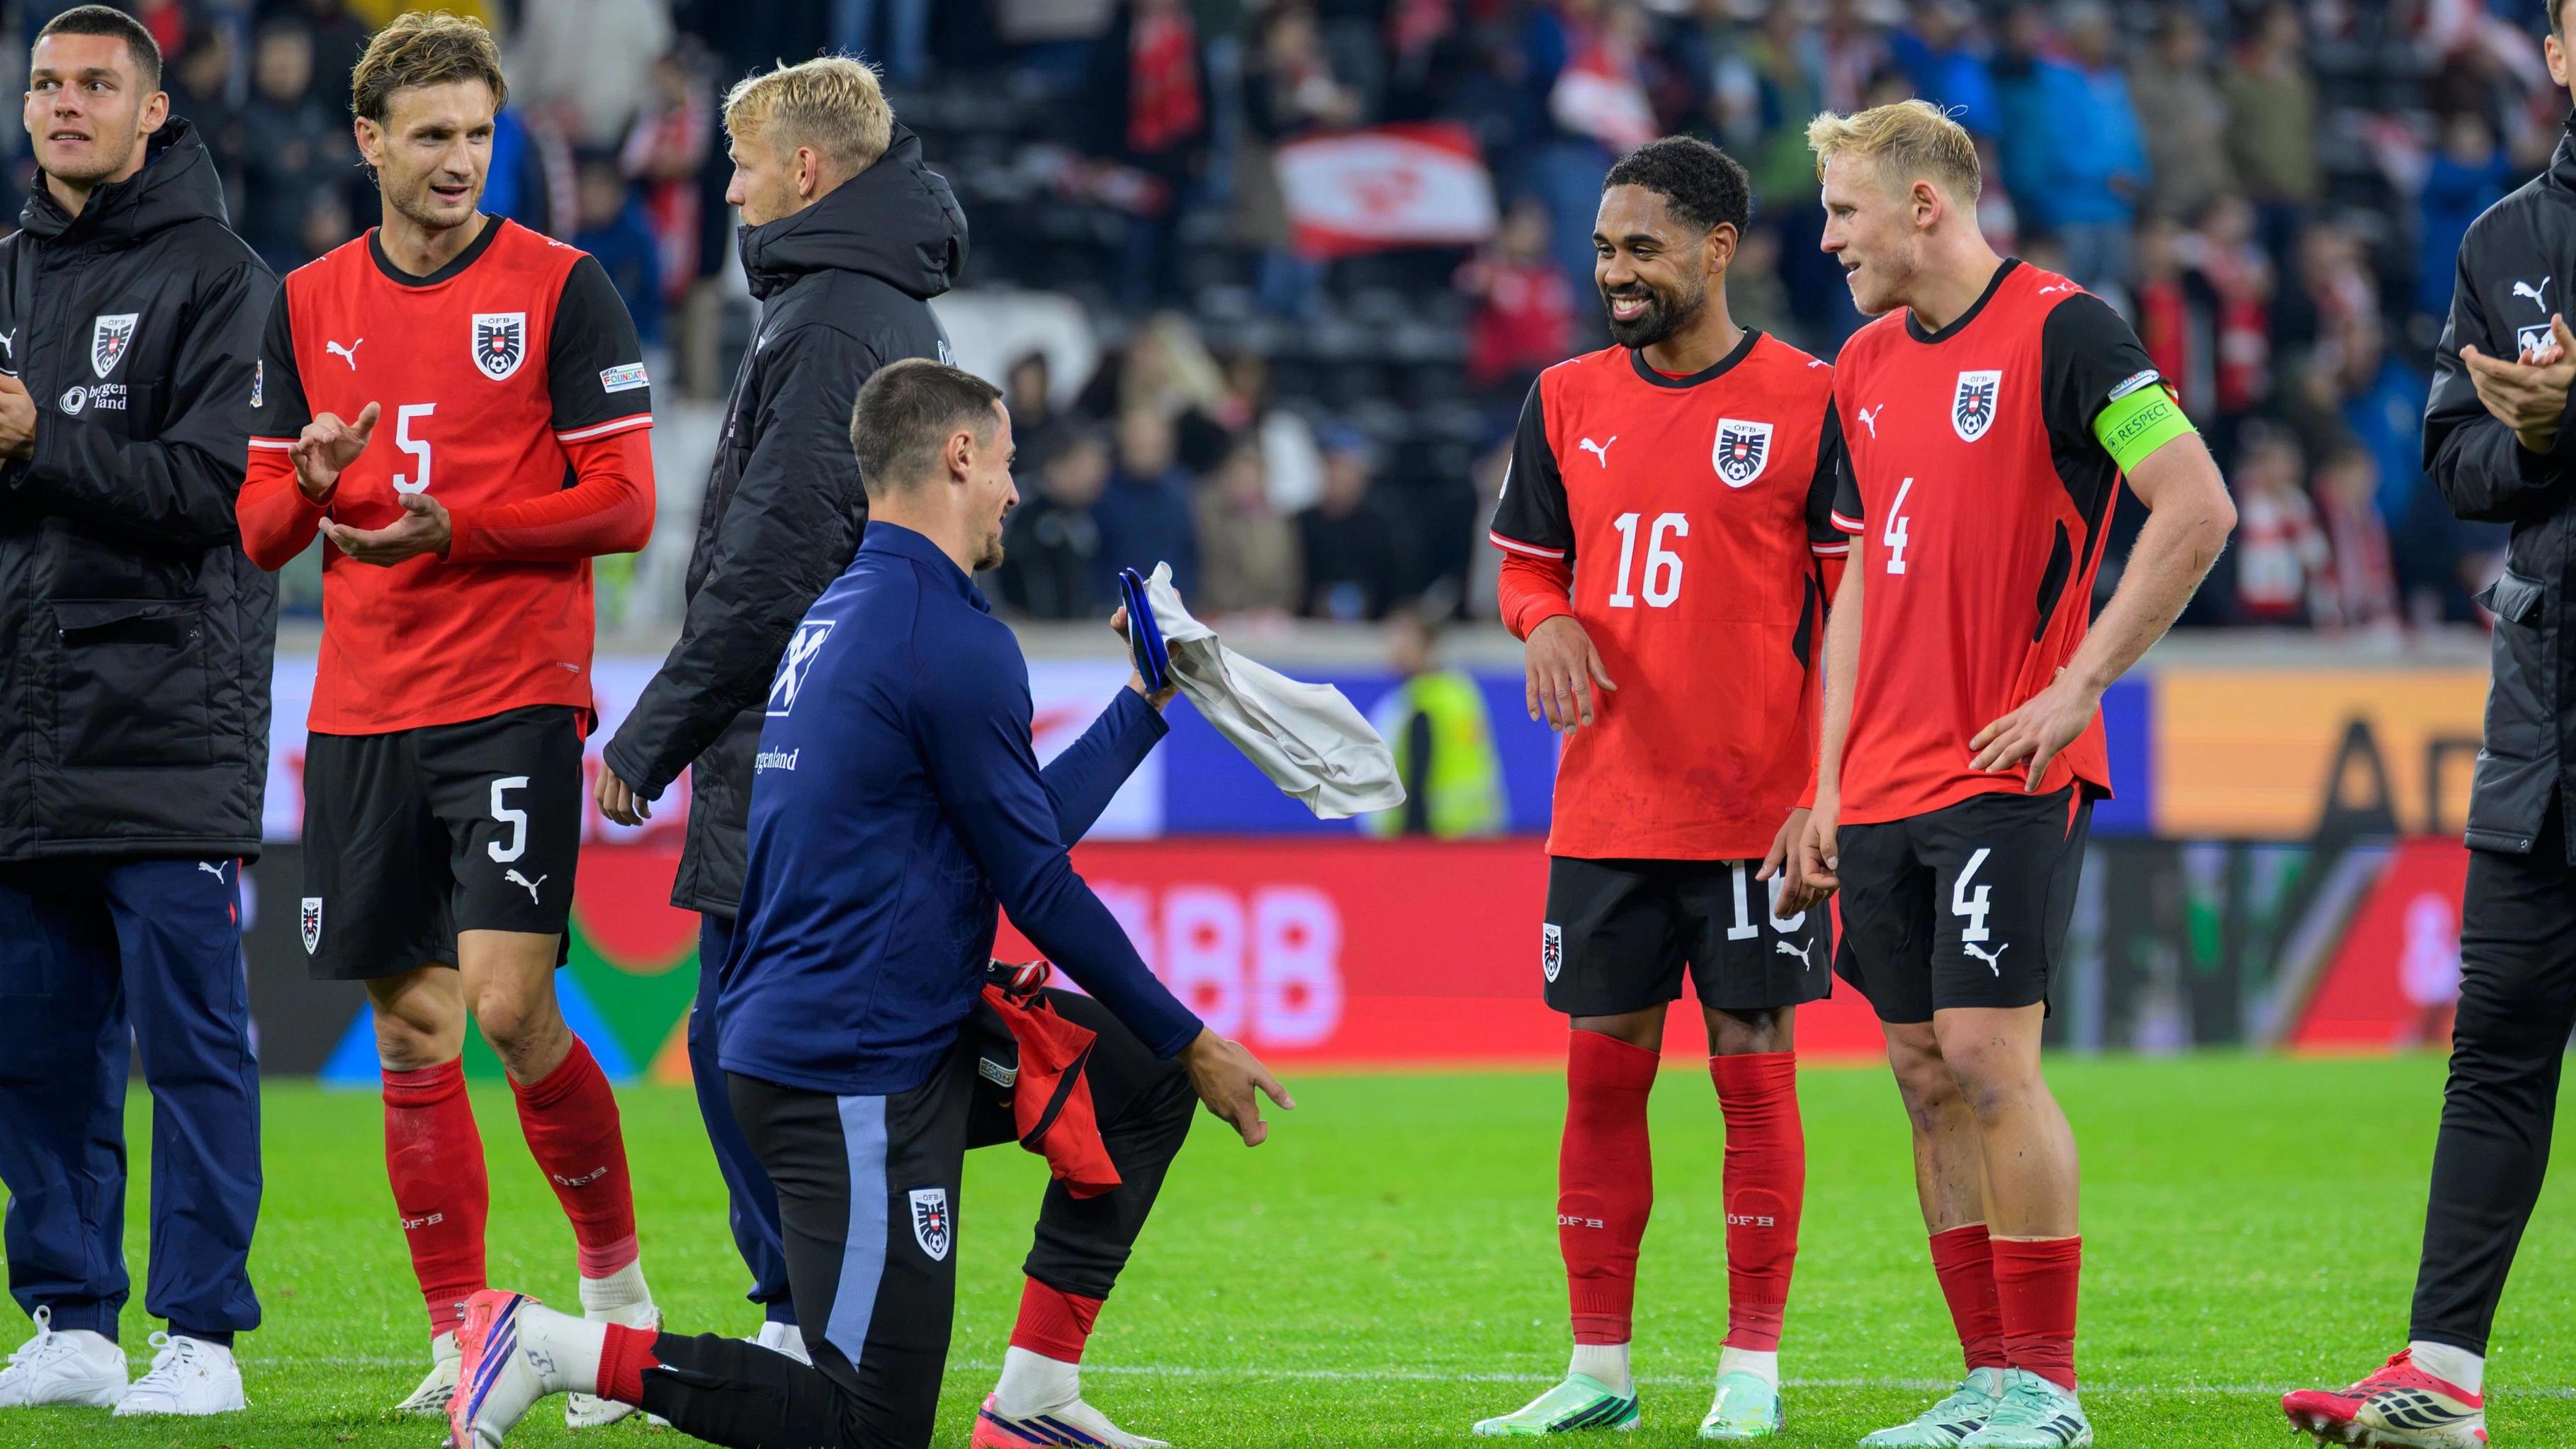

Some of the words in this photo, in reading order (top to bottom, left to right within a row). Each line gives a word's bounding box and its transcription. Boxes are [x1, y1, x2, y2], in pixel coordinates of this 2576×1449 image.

[94, 395, 126, 410] land
[2118, 403, 2169, 441] RESPECT
[393, 403, 436, 495] 5
[1610, 513, 1689, 608] 16
[1884, 478, 1914, 575] 4
[488, 777, 530, 862] 5
[1952, 849, 1992, 941] 4
[1557, 1214, 1603, 1229] ÖFB
[1727, 1212, 1774, 1227] ÖFB
